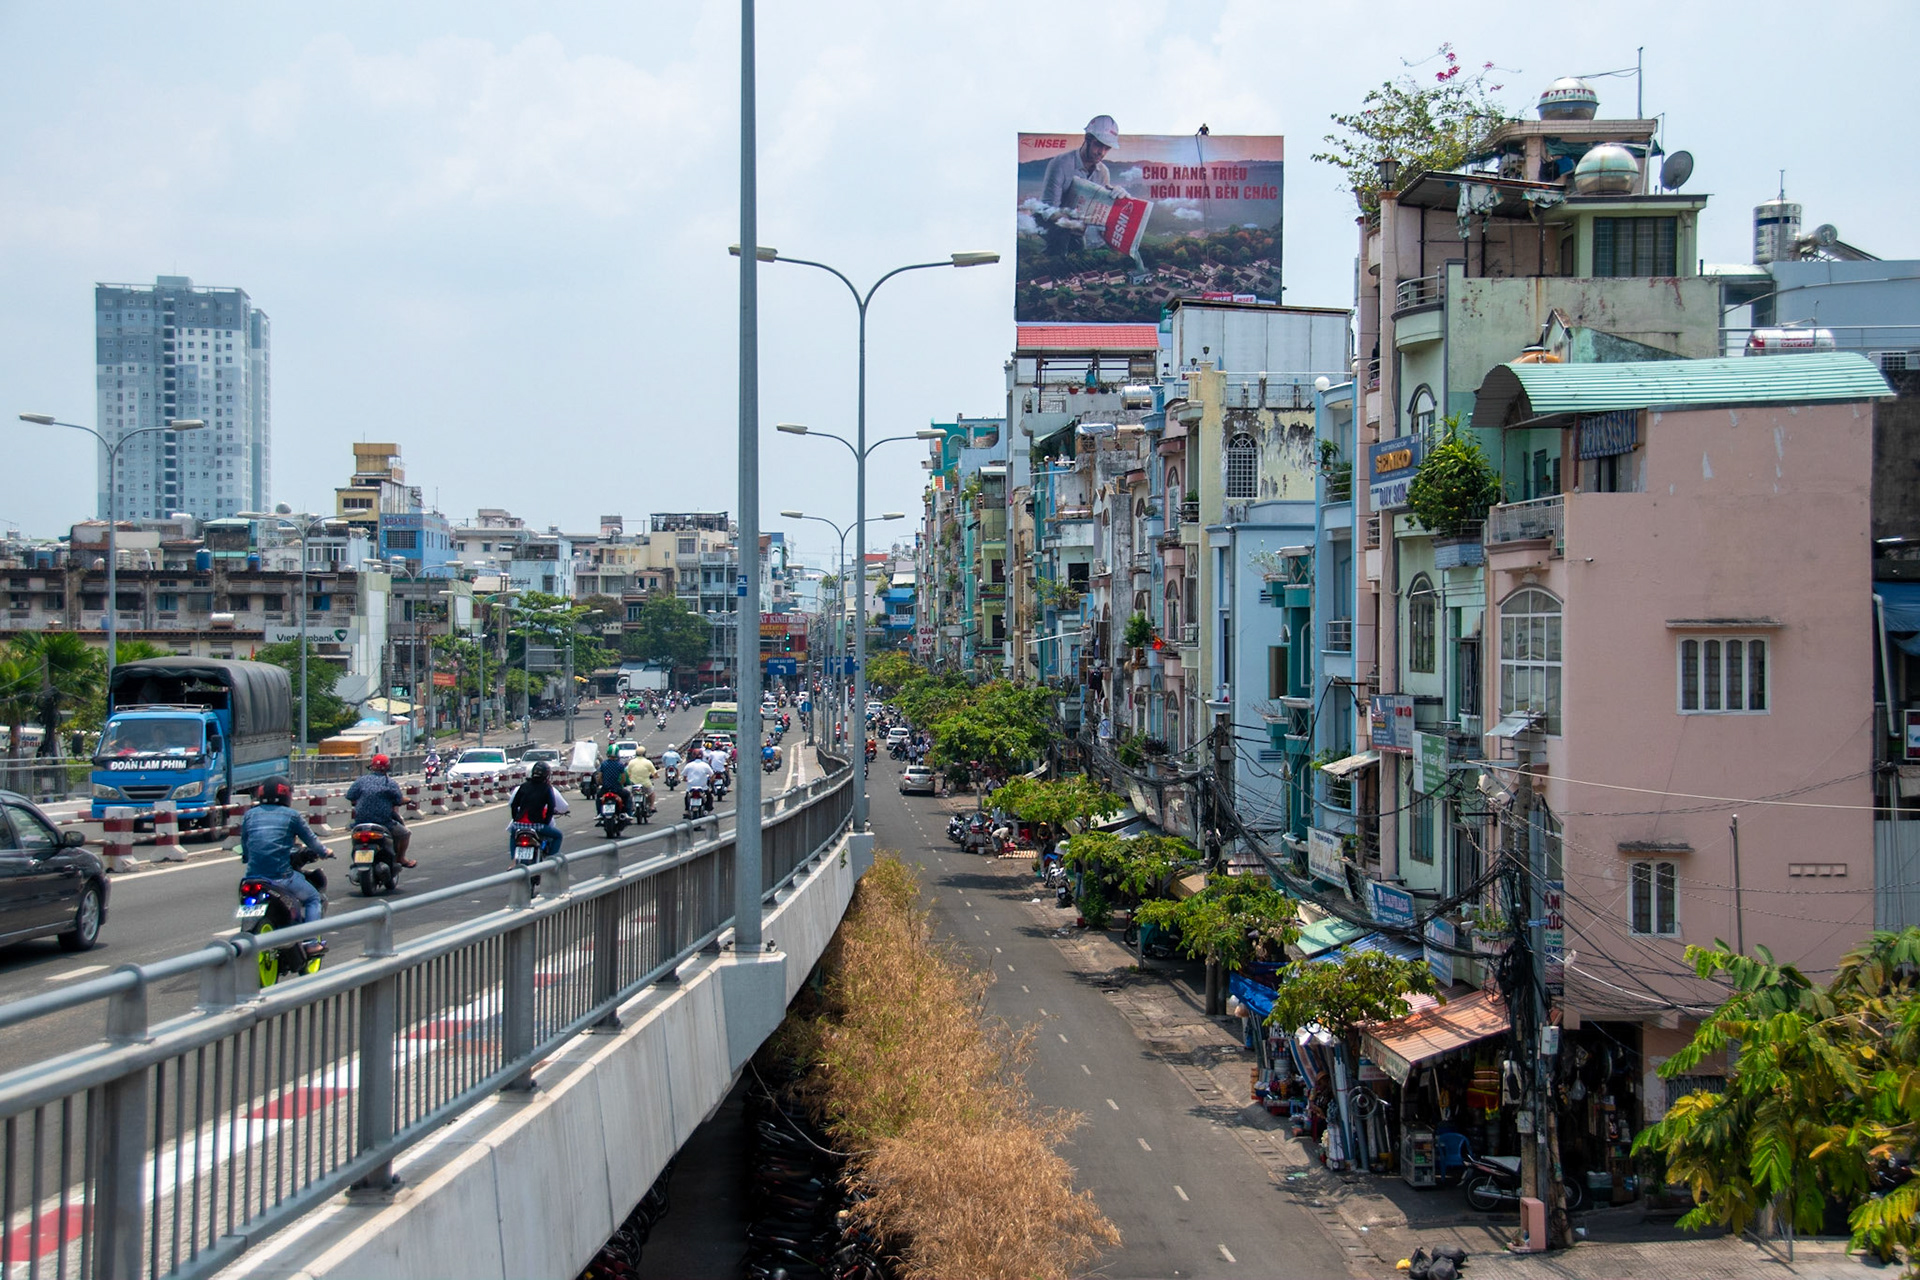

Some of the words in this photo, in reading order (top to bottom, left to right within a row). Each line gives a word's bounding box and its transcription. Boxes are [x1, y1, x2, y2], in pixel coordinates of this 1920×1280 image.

[1034, 139, 1067, 149] INSEE
[1142, 166, 1168, 180] CHO
[1212, 165, 1248, 183] TRIỆU
[1150, 184, 1181, 199] NGÔI
[1111, 213, 1130, 248] INSEE
[1375, 449, 1412, 474] SENKO
[276, 633, 335, 643] Vietmbank
[111, 758, 138, 770] ĐOÀN
[161, 760, 187, 769] PHIM
